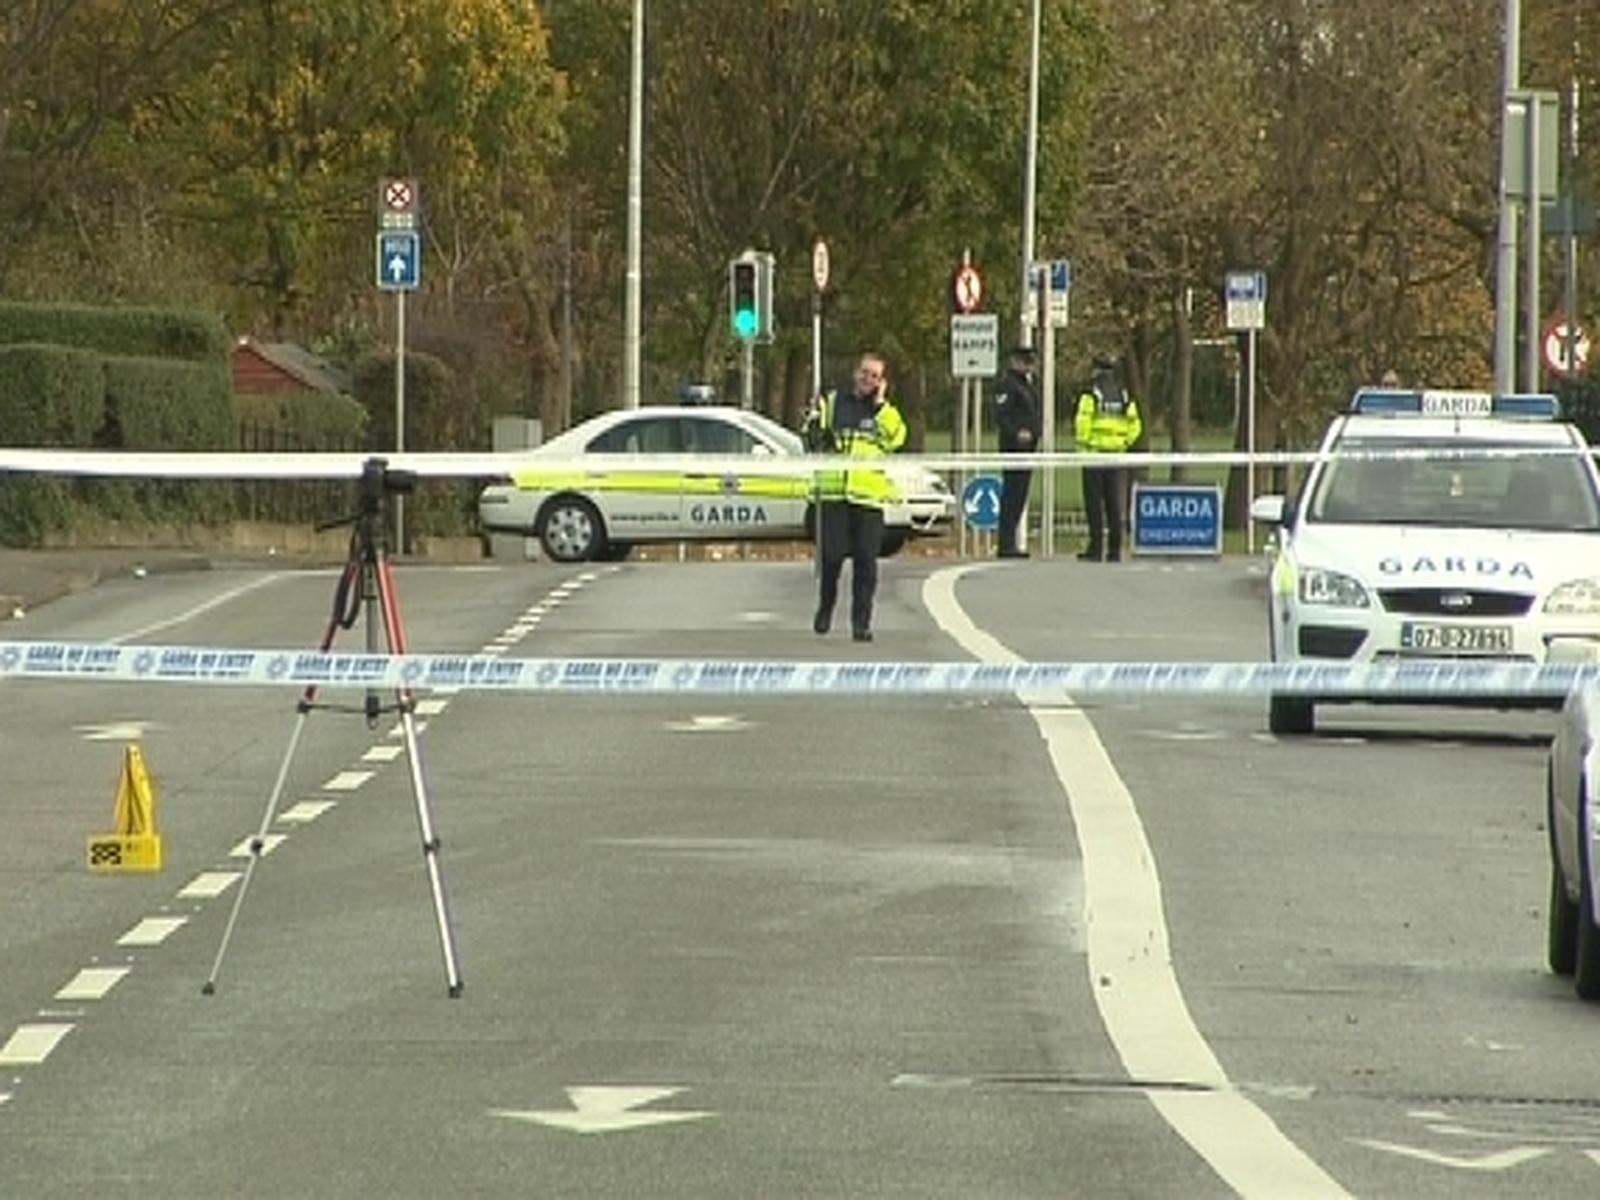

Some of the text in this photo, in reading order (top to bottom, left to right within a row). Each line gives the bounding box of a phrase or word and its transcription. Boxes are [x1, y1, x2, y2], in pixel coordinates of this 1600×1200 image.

[1423, 395, 1489, 412] GARDA
[690, 504, 767, 522] GARDA
[1141, 495, 1213, 517] GARDA
[1139, 528, 1213, 542] CHECKPOINT
[1379, 557, 1534, 579] GARDA
